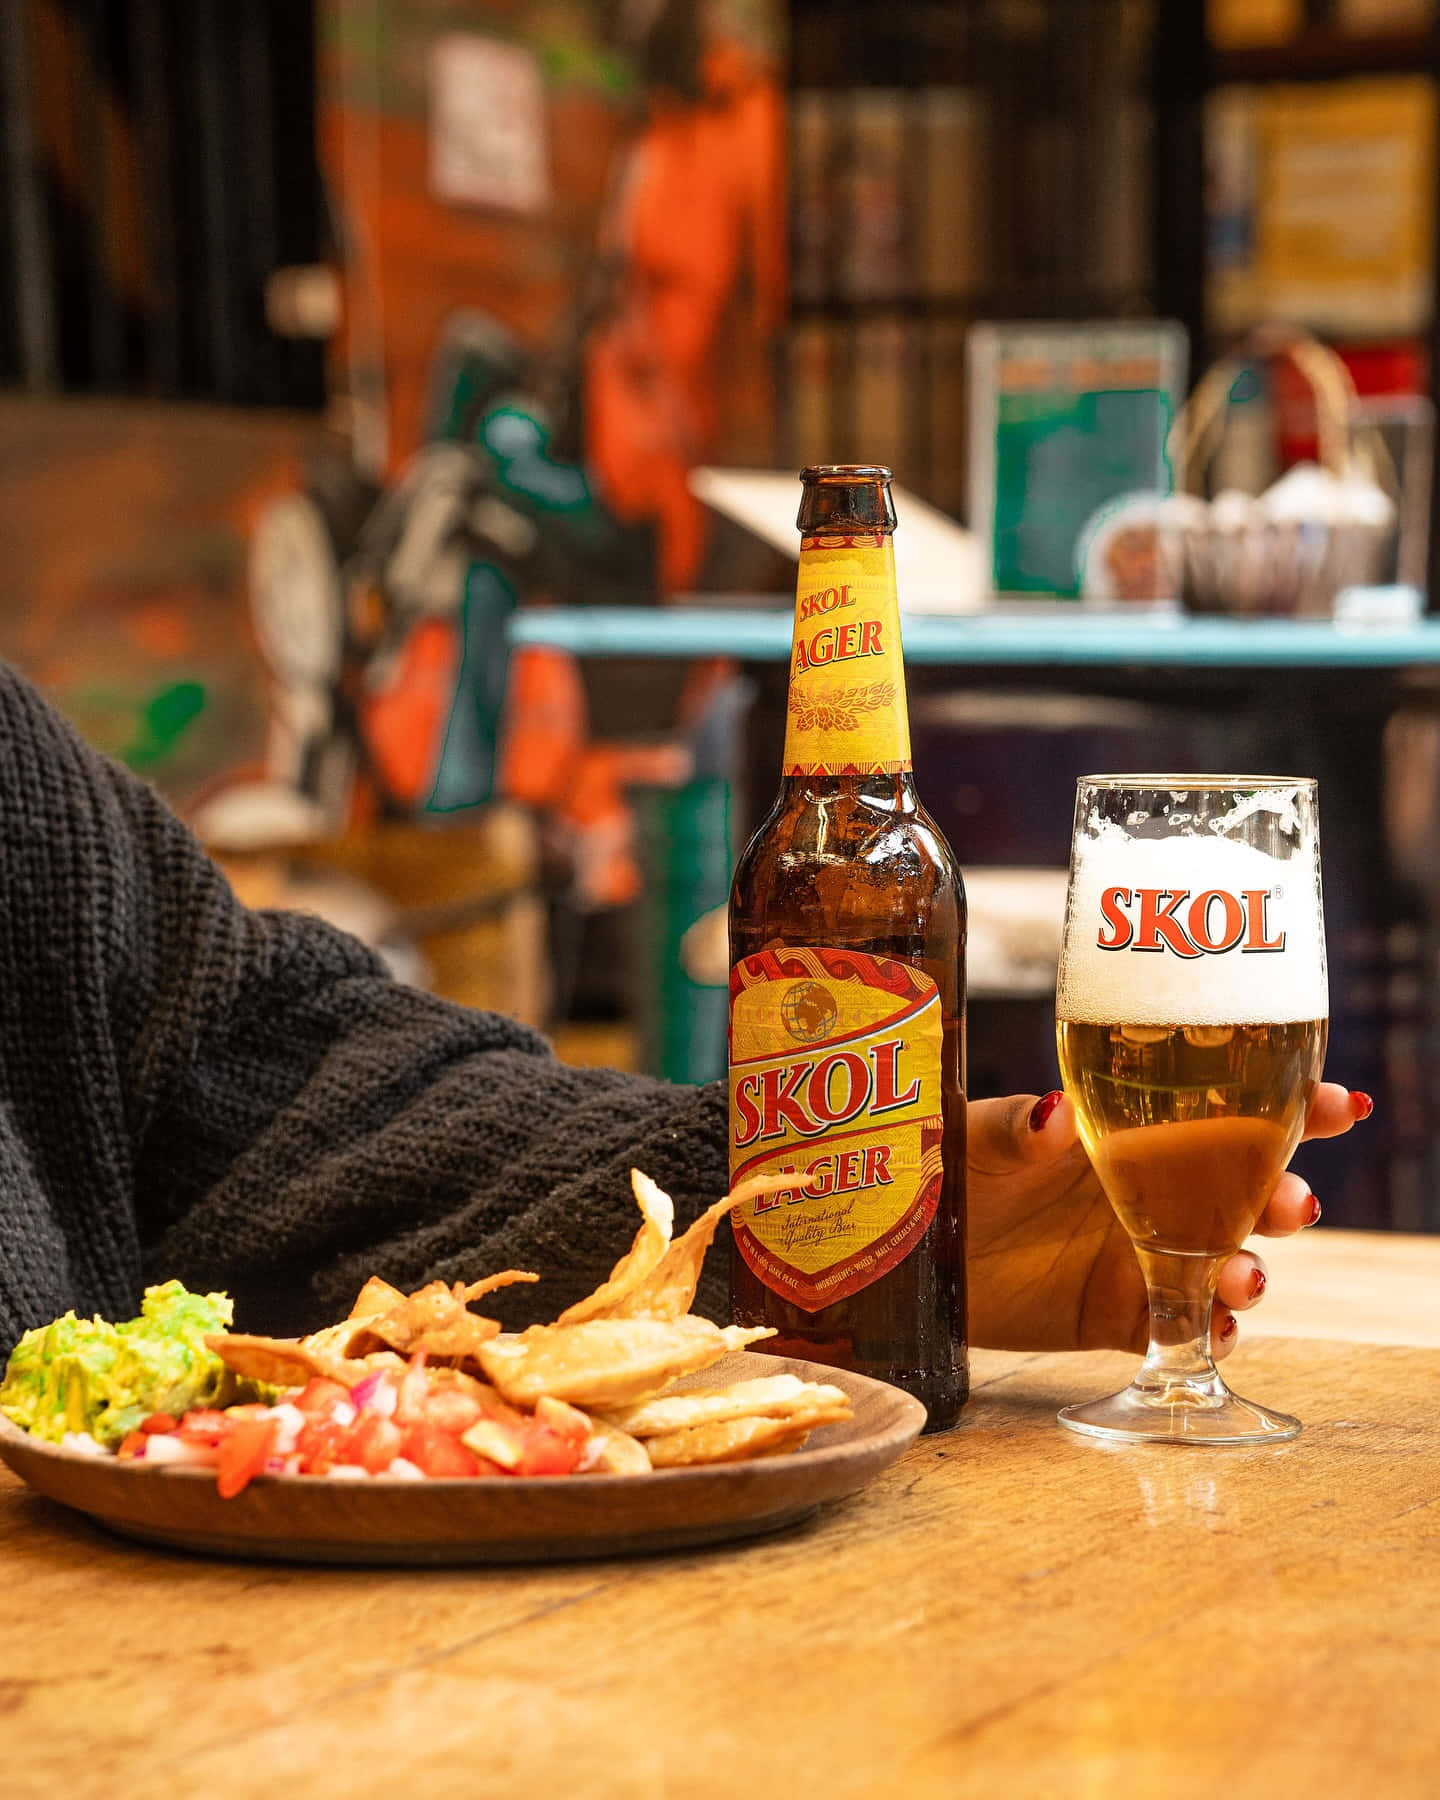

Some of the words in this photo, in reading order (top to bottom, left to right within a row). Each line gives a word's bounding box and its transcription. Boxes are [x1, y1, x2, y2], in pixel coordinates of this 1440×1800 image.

[799, 585, 856, 622] SKOL
[790, 621, 885, 681] AGER
[734, 1038, 922, 1150] SKOL
[782, 1198, 856, 1231] International
[783, 1226, 826, 1253] Quality
[829, 1217, 857, 1234] Beer
